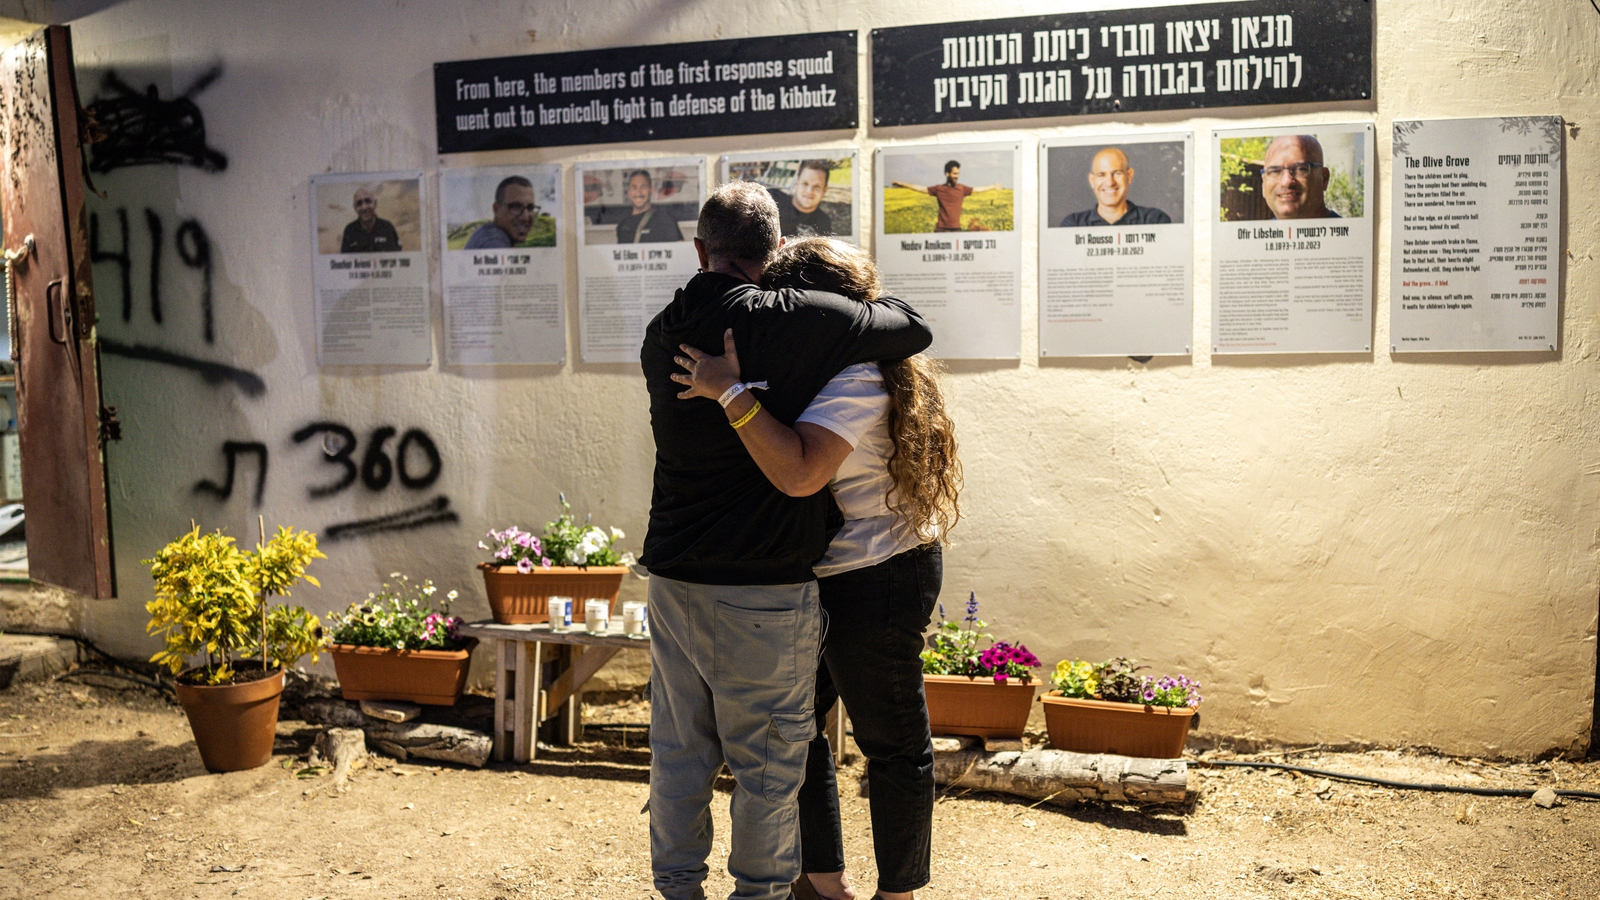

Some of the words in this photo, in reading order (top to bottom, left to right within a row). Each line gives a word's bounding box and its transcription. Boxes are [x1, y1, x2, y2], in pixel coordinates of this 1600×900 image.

[942, 32, 1022, 68] הכוננות
[1033, 28, 1089, 62] כיתת
[1100, 23, 1154, 57] חברי
[1166, 18, 1219, 53] יצאו
[1232, 14, 1292, 53] מכאן
[457, 77, 489, 99] From
[495, 74, 529, 98] here,
[534, 72, 555, 94] the
[561, 67, 625, 92] members
[630, 64, 644, 87] of
[650, 62, 673, 86] the
[678, 60, 709, 84] first
[715, 60, 782, 84] response
[787, 50, 833, 80] squad
[1018, 69, 1071, 103] הגנת
[1081, 64, 1111, 99] על
[1122, 61, 1204, 97] בגבורה
[1216, 52, 1301, 91] להילחם
[457, 108, 488, 130] went
[494, 106, 515, 127] out
[521, 104, 534, 126] to
[539, 99, 608, 128] heroically
[614, 96, 645, 122] fight
[650, 97, 663, 117] in
[669, 90, 725, 116] defense
[730, 89, 745, 112] of
[750, 87, 774, 111] the
[780, 82, 836, 110] kibbutz
[934, 73, 1007, 112] הקיבוץ
[1405, 156, 1419, 168] The
[1422, 156, 1442, 167] Olive
[1446, 154, 1469, 166] Grove
[1075, 234, 1085, 244] Uri
[1087, 233, 1113, 244] Rousso
[1238, 228, 1250, 239] Ofir
[1253, 227, 1283, 238] Libstein
[1330, 226, 1348, 236] אופיר
[292, 421, 443, 497] 360
